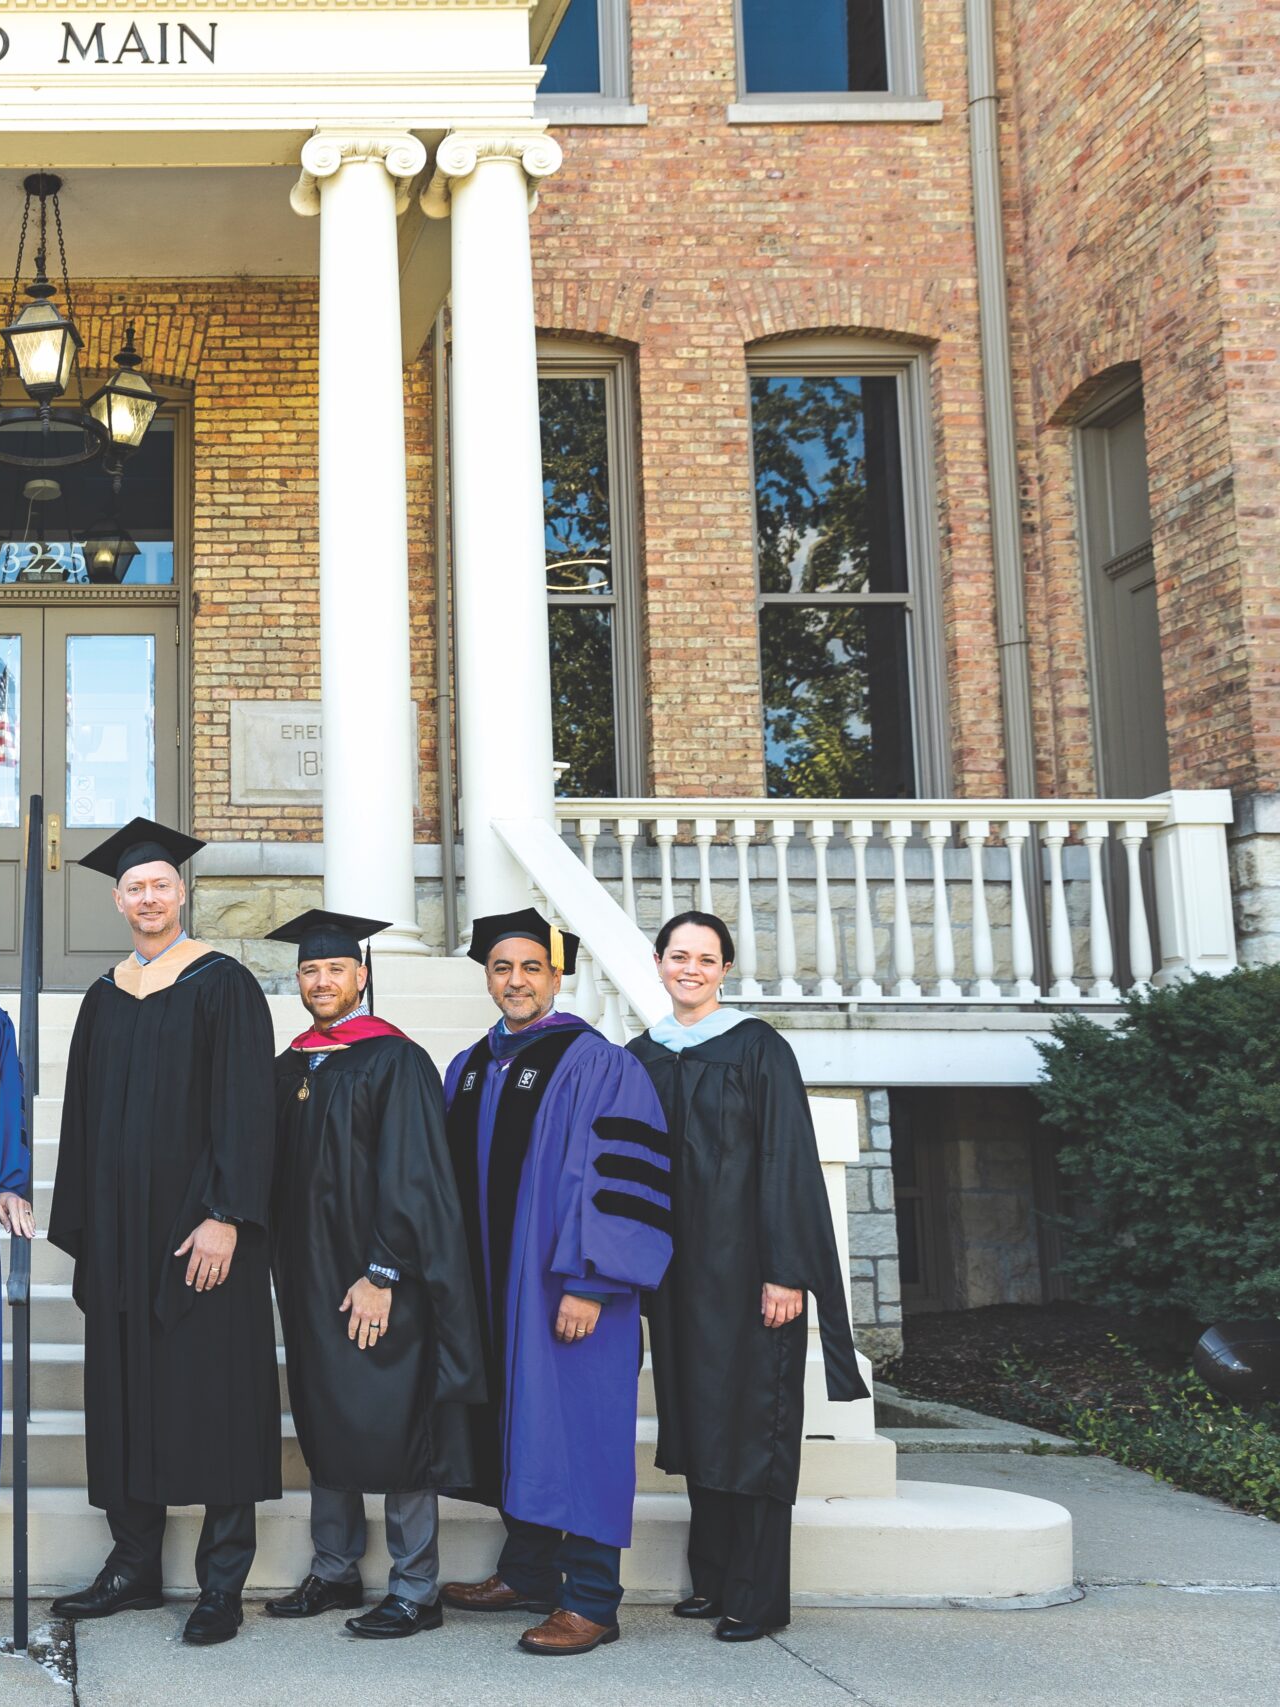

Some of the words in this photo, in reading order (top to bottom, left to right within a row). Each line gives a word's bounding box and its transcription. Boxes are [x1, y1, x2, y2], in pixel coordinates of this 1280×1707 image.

[58, 21, 218, 64] MAIN
[1, 541, 88, 575] 3225
[281, 725, 324, 739] ERE
[297, 751, 324, 777] 18
